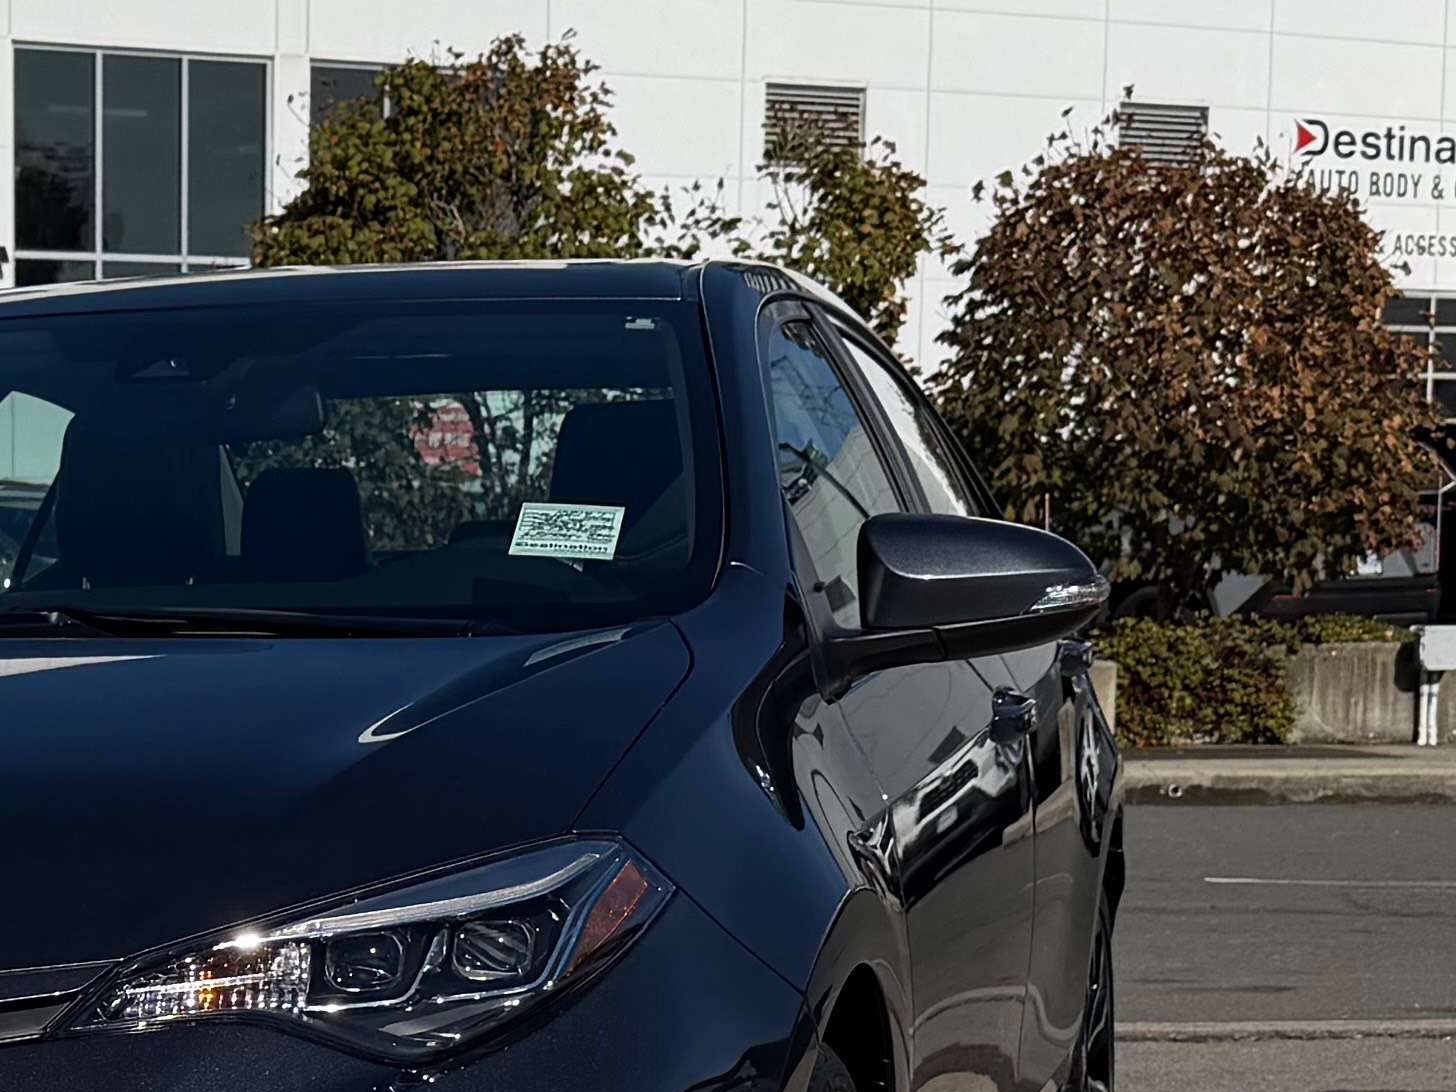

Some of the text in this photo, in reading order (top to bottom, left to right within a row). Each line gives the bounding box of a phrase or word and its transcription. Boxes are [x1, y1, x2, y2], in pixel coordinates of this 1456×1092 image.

[1306, 168, 1359, 196] AUTO
[1369, 171, 1422, 198] BODY
[1431, 174, 1444, 199] &
